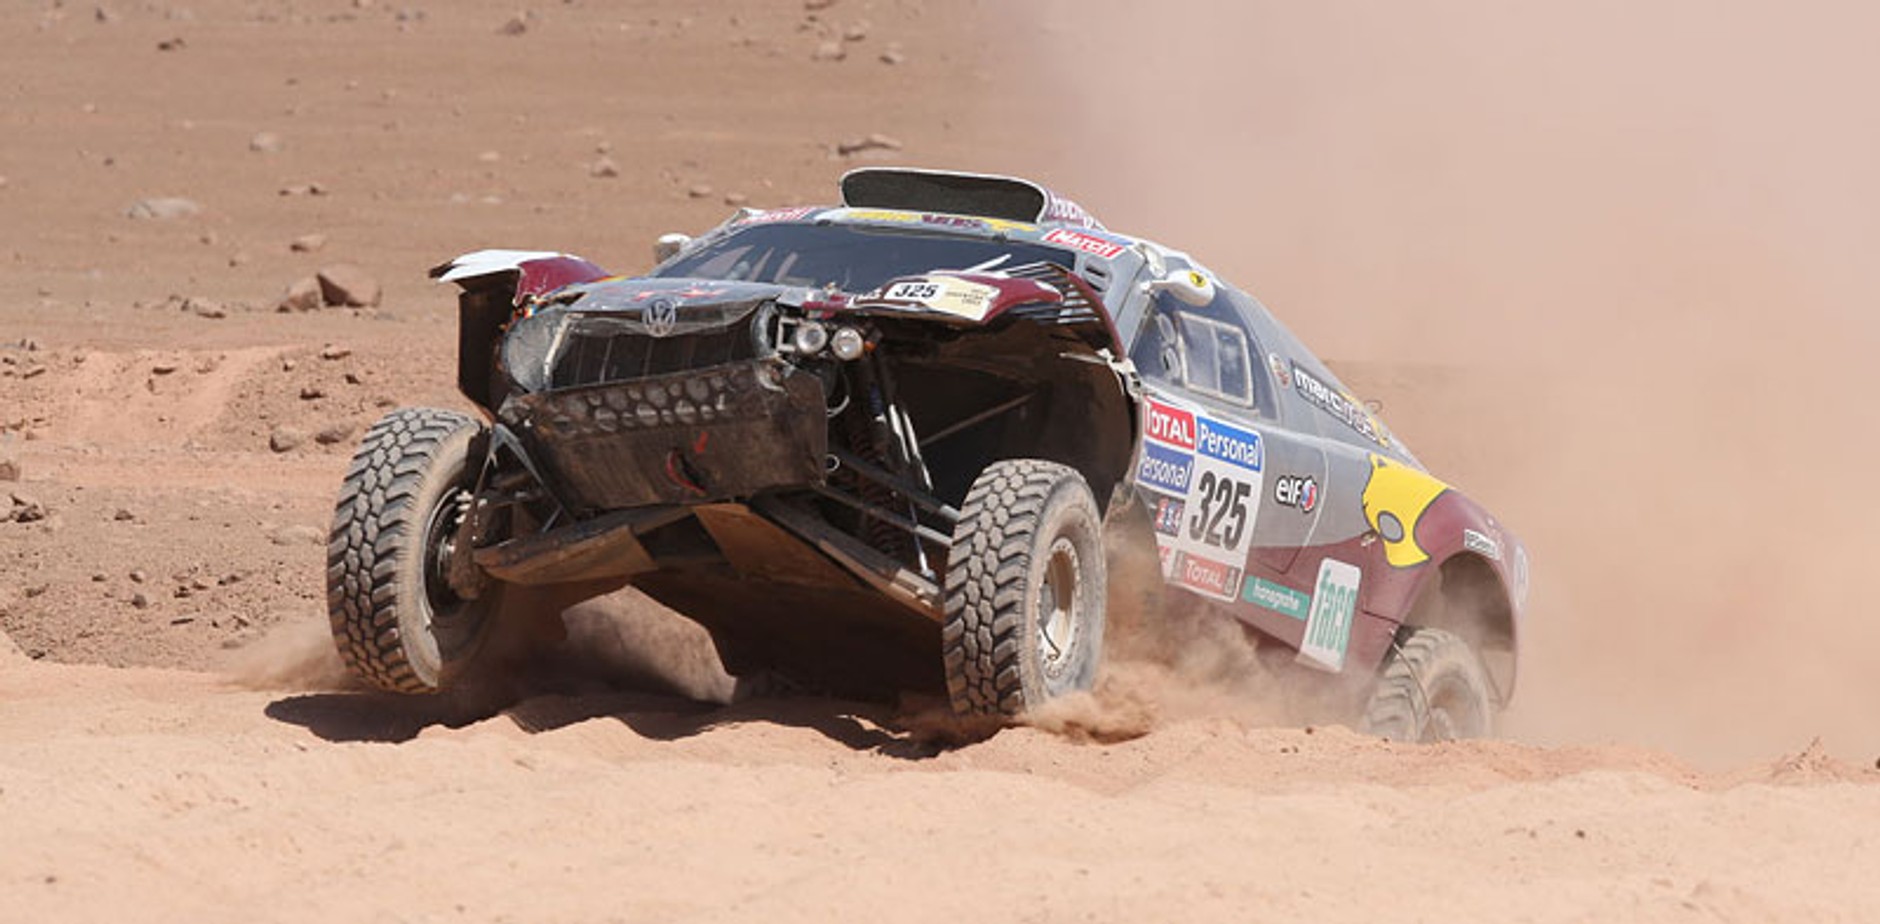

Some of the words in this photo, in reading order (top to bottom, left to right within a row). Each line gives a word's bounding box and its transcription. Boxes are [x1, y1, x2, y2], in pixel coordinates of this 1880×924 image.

[1055, 230, 1119, 256] MATCH
[894, 284, 939, 299] 325
[1145, 401, 1194, 444] TOTAL
[1198, 423, 1260, 468] Personal
[1275, 474, 1303, 507] elf
[1189, 470, 1252, 551] 325
[1185, 558, 1224, 586] TOTAL
